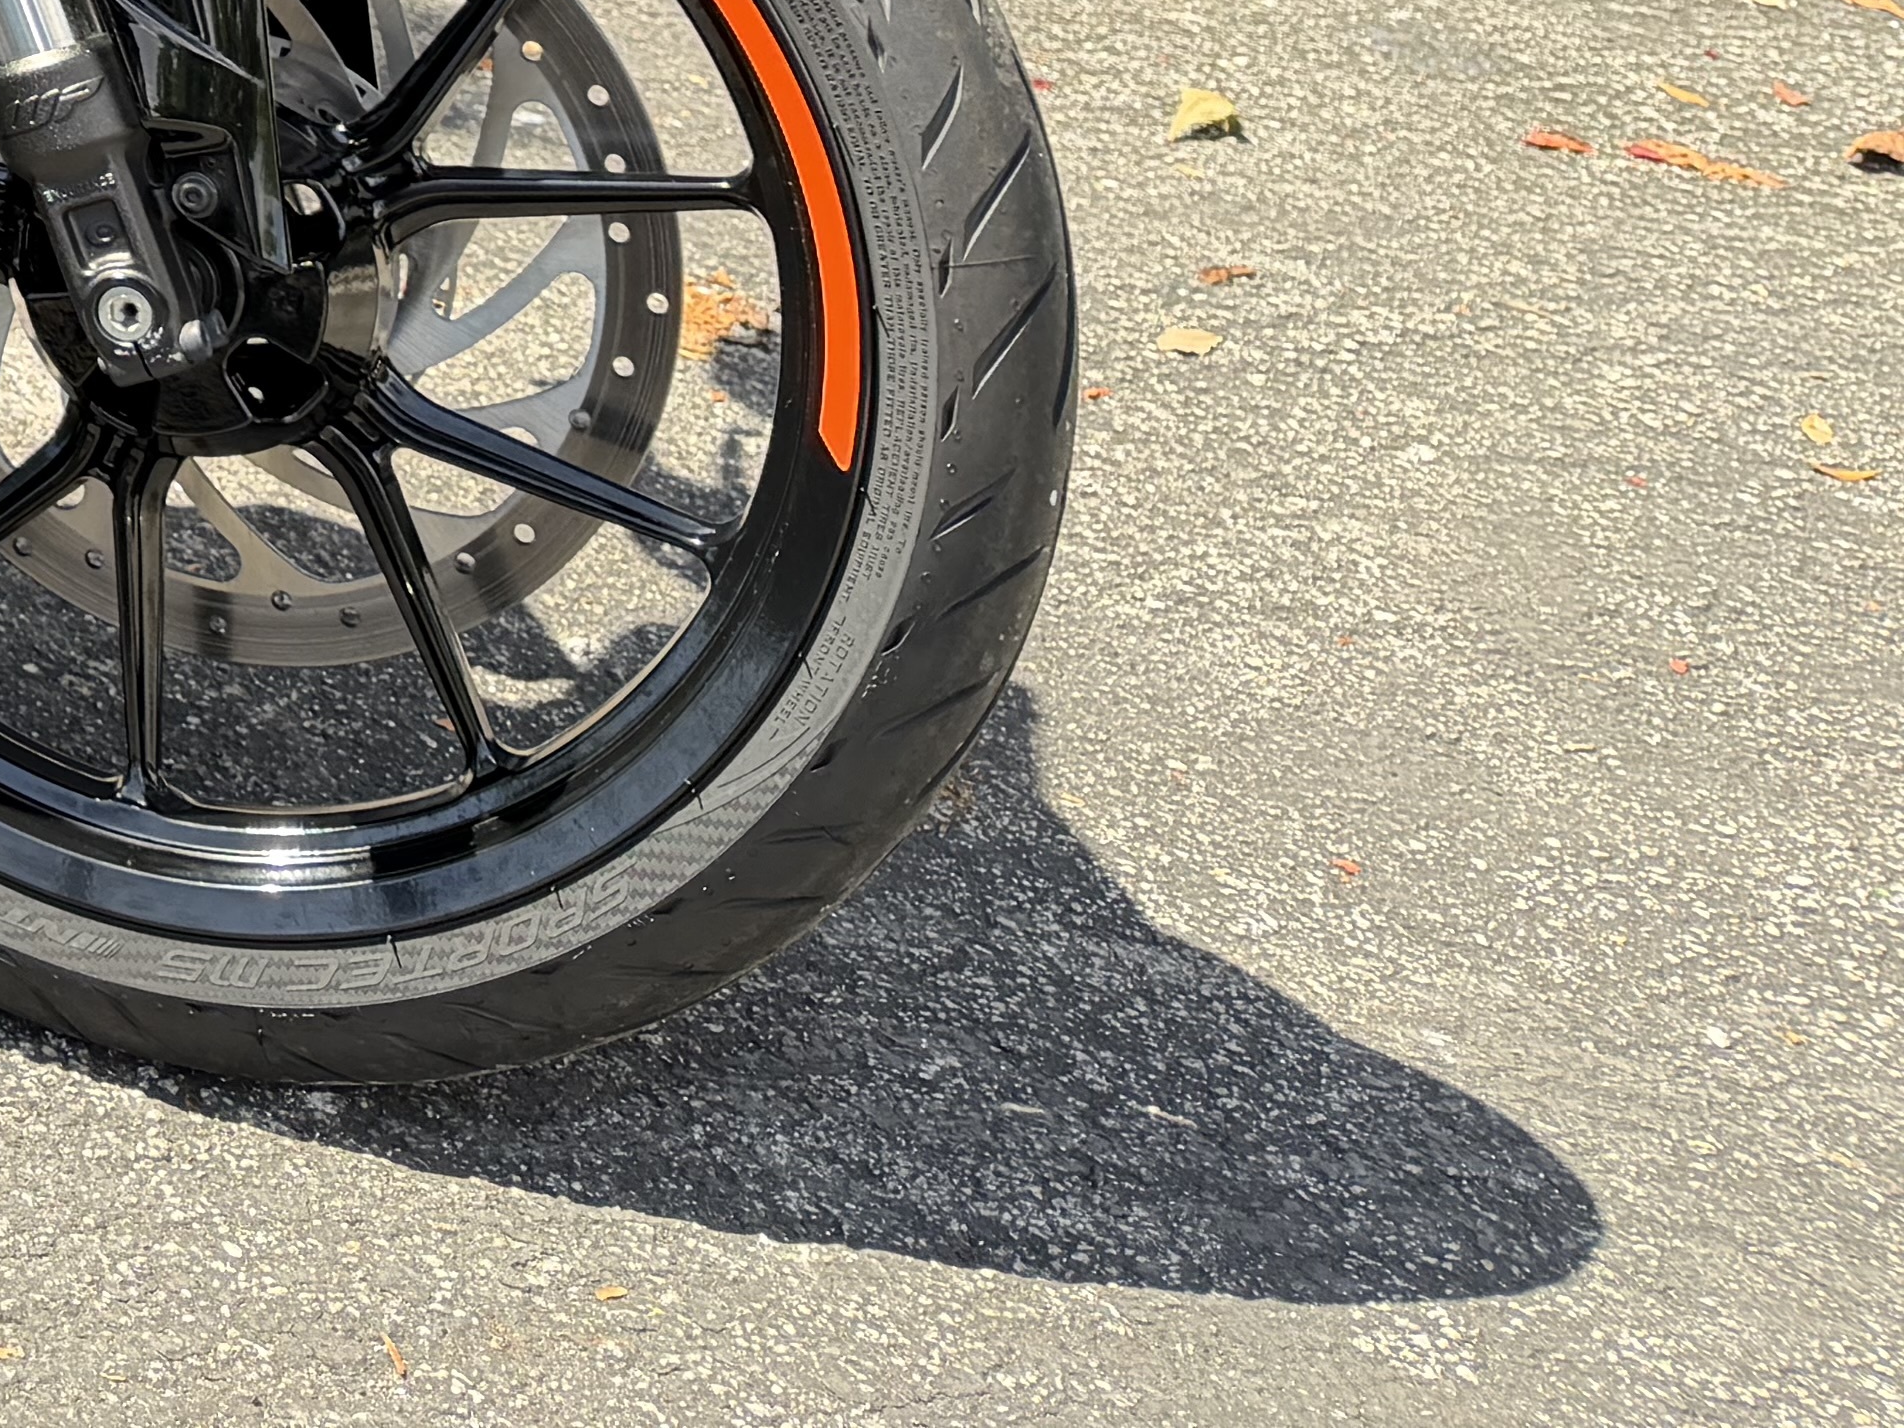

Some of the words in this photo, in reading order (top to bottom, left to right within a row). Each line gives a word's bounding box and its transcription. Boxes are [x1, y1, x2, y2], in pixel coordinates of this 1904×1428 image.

[772, 676, 811, 728] WHEEL
[792, 631, 855, 728] ROTATION
[282, 857, 652, 991] SPORTEC
